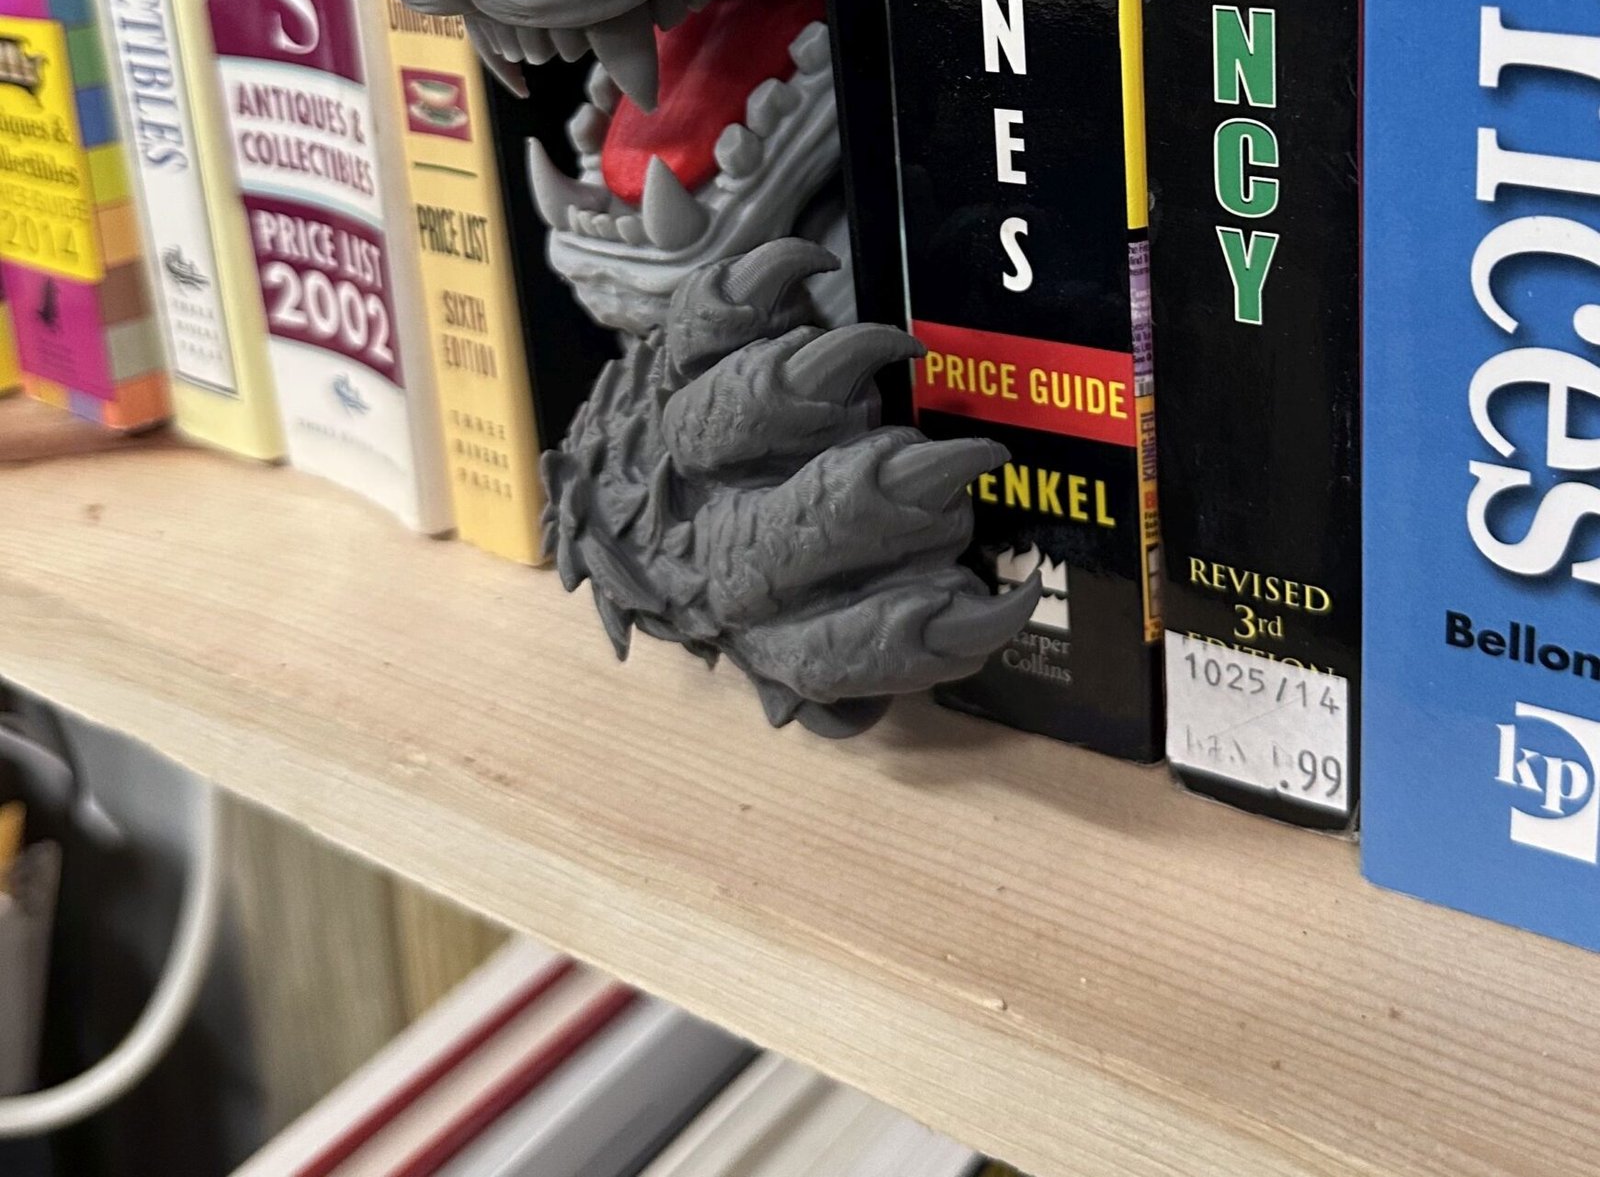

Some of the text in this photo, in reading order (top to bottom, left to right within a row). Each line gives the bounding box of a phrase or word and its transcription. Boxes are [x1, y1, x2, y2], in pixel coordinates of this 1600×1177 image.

[236, 82, 366, 145] ANTIQUES &
[241, 131, 375, 198] COLLECTIBLES
[254, 208, 383, 290] PRICE LIST
[416, 203, 490, 264] PRICE LIST
[262, 261, 395, 364] 2002
[442, 289, 488, 334] SIXTH
[441, 333, 498, 379] EDITION
[925, 350, 1128, 419] PRICE GUIDE
[966, 461, 1117, 527] ENKEL
[1188, 556, 1331, 613] REVISED
[1013, 629, 1071, 656] arper
[1234, 604, 1283, 639] 3rd
[1002, 647, 1073, 683] Collins
[1494, 723, 1589, 815] kp
